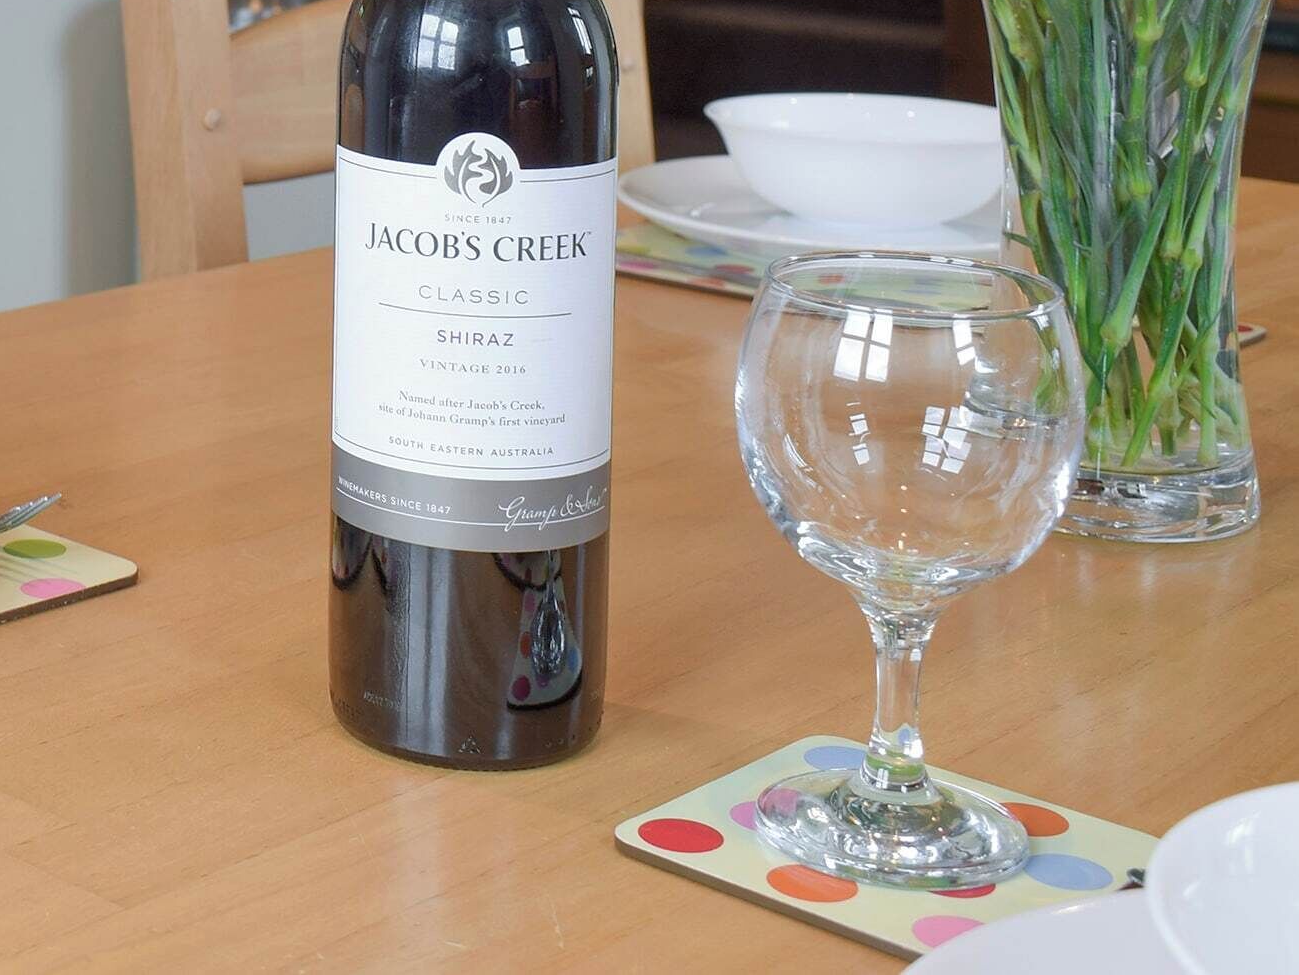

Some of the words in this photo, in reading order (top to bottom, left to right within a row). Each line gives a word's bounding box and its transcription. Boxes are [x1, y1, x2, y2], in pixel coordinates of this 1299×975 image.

[444, 213, 480, 224] SINCE
[485, 216, 512, 225] 1847
[365, 222, 481, 261] JACOB'S
[418, 284, 529, 305] CLASSIC
[436, 329, 515, 347] SHIRAZ
[419, 358, 490, 374] VINTAGE
[496, 365, 527, 375] 2016
[399, 390, 436, 406] Named
[439, 398, 465, 408] after
[467, 399, 508, 411] Jacob's
[378, 403, 394, 414] site
[396, 406, 407, 416] of
[407, 409, 446, 423] Johann
[449, 414, 495, 428] Gramp's
[499, 416, 520, 426] first
[524, 413, 566, 428] vineyard
[388, 435, 424, 450] SOUTH
[430, 443, 484, 456] EASTERN
[491, 447, 554, 457] AUSTRALIA
[338, 474, 387, 504] WINEMAKERS
[390, 496, 422, 511] SINCE
[426, 503, 451, 515] 1847
